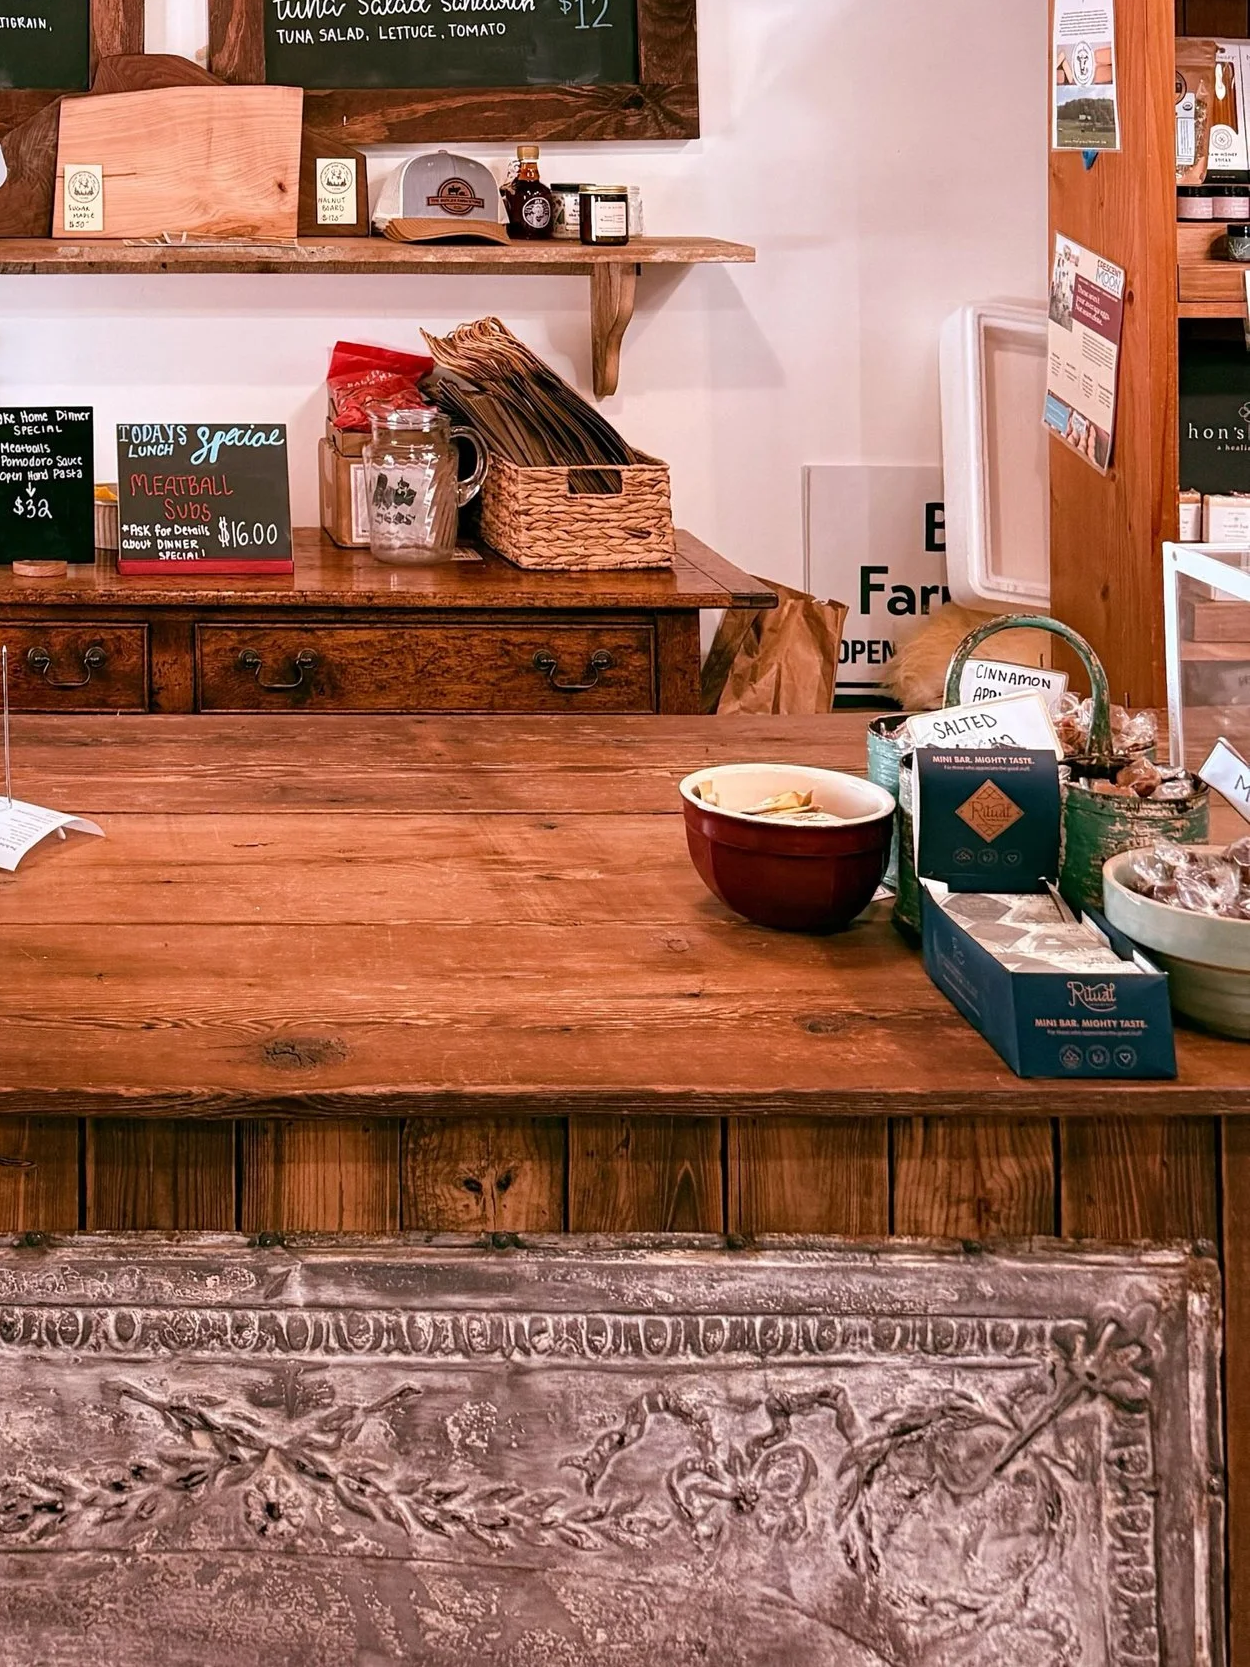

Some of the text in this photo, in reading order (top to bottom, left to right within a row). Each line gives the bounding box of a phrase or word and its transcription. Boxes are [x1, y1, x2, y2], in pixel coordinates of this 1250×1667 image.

[20, 410, 48, 422] Home
[56, 410, 90, 421] Dinner
[14, 424, 62, 436] SPECIAL
[1188, 422, 1244, 440] hon's
[0, 442, 50, 454] Meatballs
[118, 424, 285, 465] TODAYS Special
[128, 444, 174, 458] LUNCH
[0, 456, 83, 467] Pomodoro Sauce
[0, 468, 83, 482] Open Hand Pasta
[130, 474, 234, 496] MEATBALL
[13, 498, 52, 519] $32
[154, 524, 172, 534] for
[174, 524, 210, 536] Details
[217, 516, 278, 548] $16.00
[122, 540, 199, 550] about DINNER
[158, 549, 206, 560] SPECIAL!
[839, 640, 895, 664] OPEN
[976, 665, 1051, 689] CINNAMON
[933, 714, 997, 740] SALTED
[1067, 981, 1116, 1012] Ritual
[1035, 1019, 1057, 1027] MINI
[1082, 1020, 1119, 1028] MIGHTY
[1120, 1020, 1148, 1028] TASTE.
